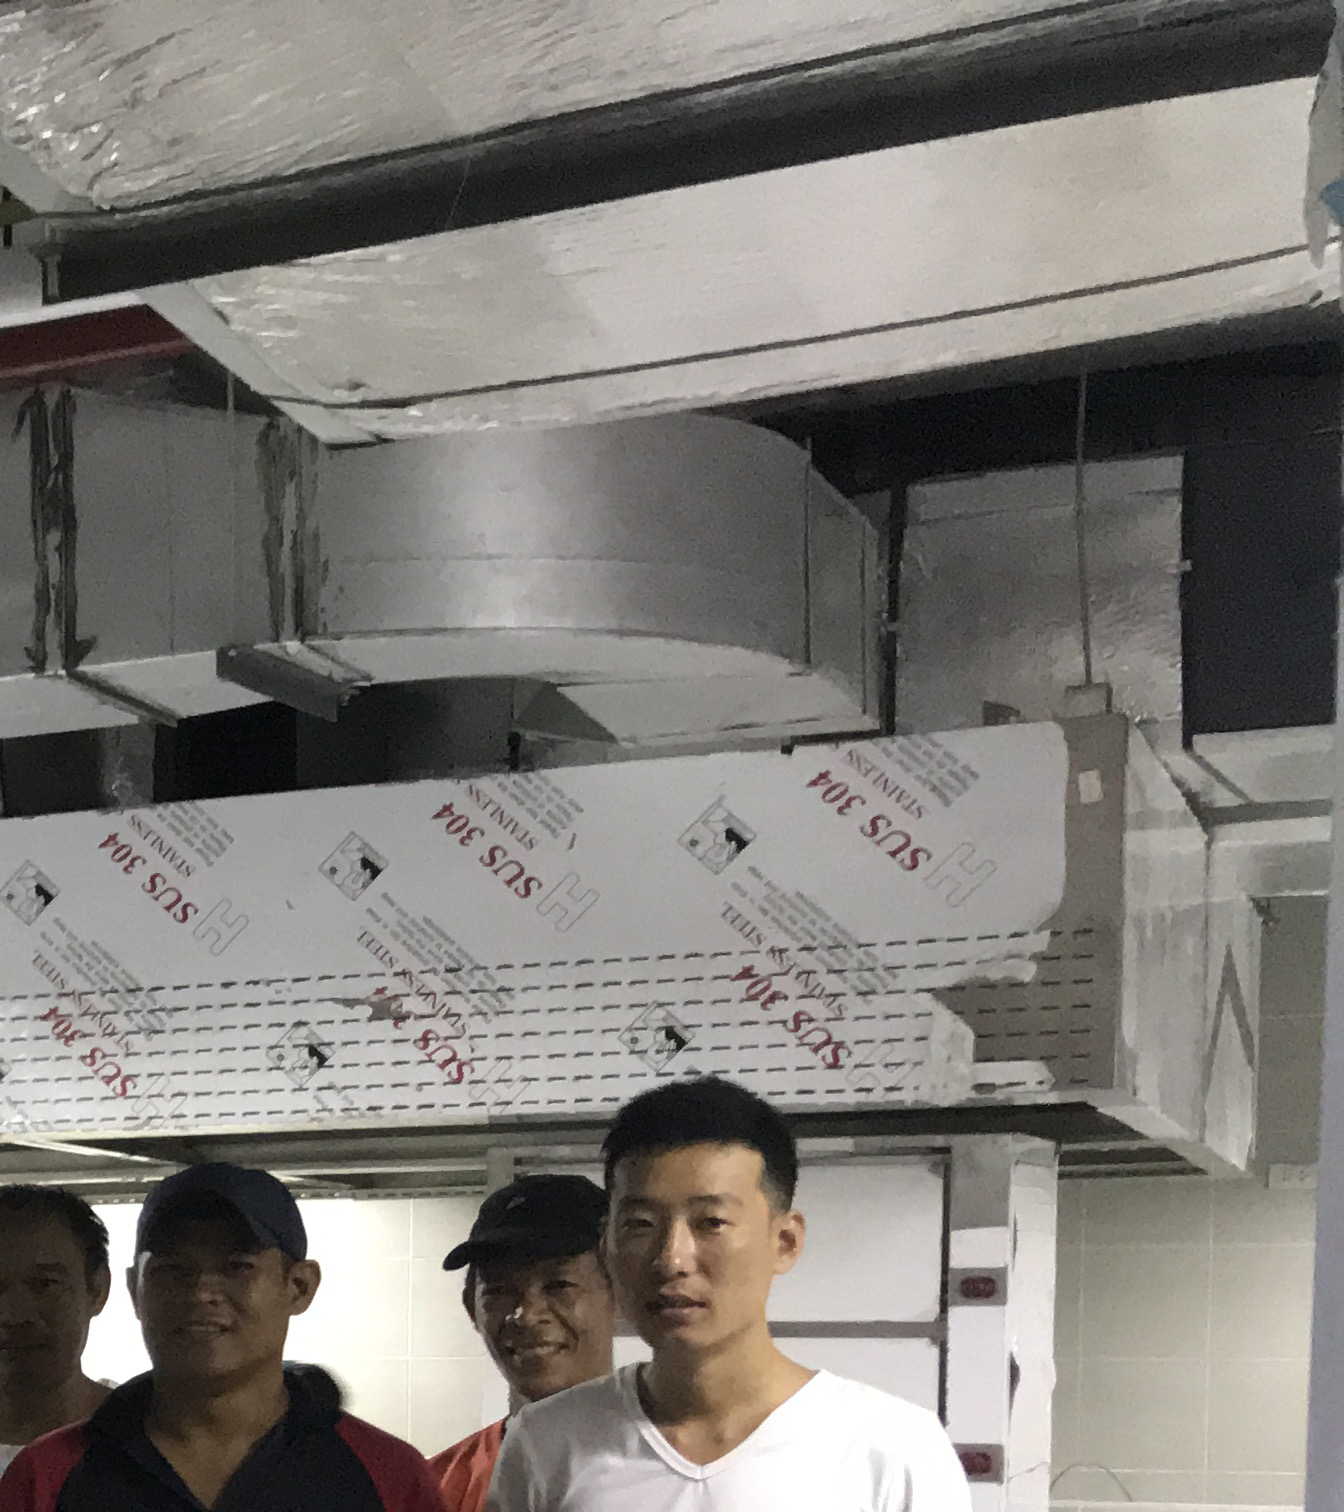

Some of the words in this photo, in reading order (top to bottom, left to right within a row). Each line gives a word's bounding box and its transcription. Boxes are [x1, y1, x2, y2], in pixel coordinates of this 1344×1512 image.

[806, 770, 866, 816] 304
[845, 749, 925, 820] STAINLESS
[431, 802, 484, 846] 304
[465, 783, 538, 851] STAINLESS
[861, 815, 933, 872] SUS
[98, 831, 147, 875] 304
[129, 814, 194, 877] STAINLESS
[479, 845, 543, 900] SUS
[141, 872, 199, 925] SUS
[731, 964, 788, 1012] 304
[42, 1006, 84, 1048] 304
[783, 1010, 853, 1069] SUS
[82, 1047, 137, 1098] SUS
[414, 1028, 475, 1084] SUS
